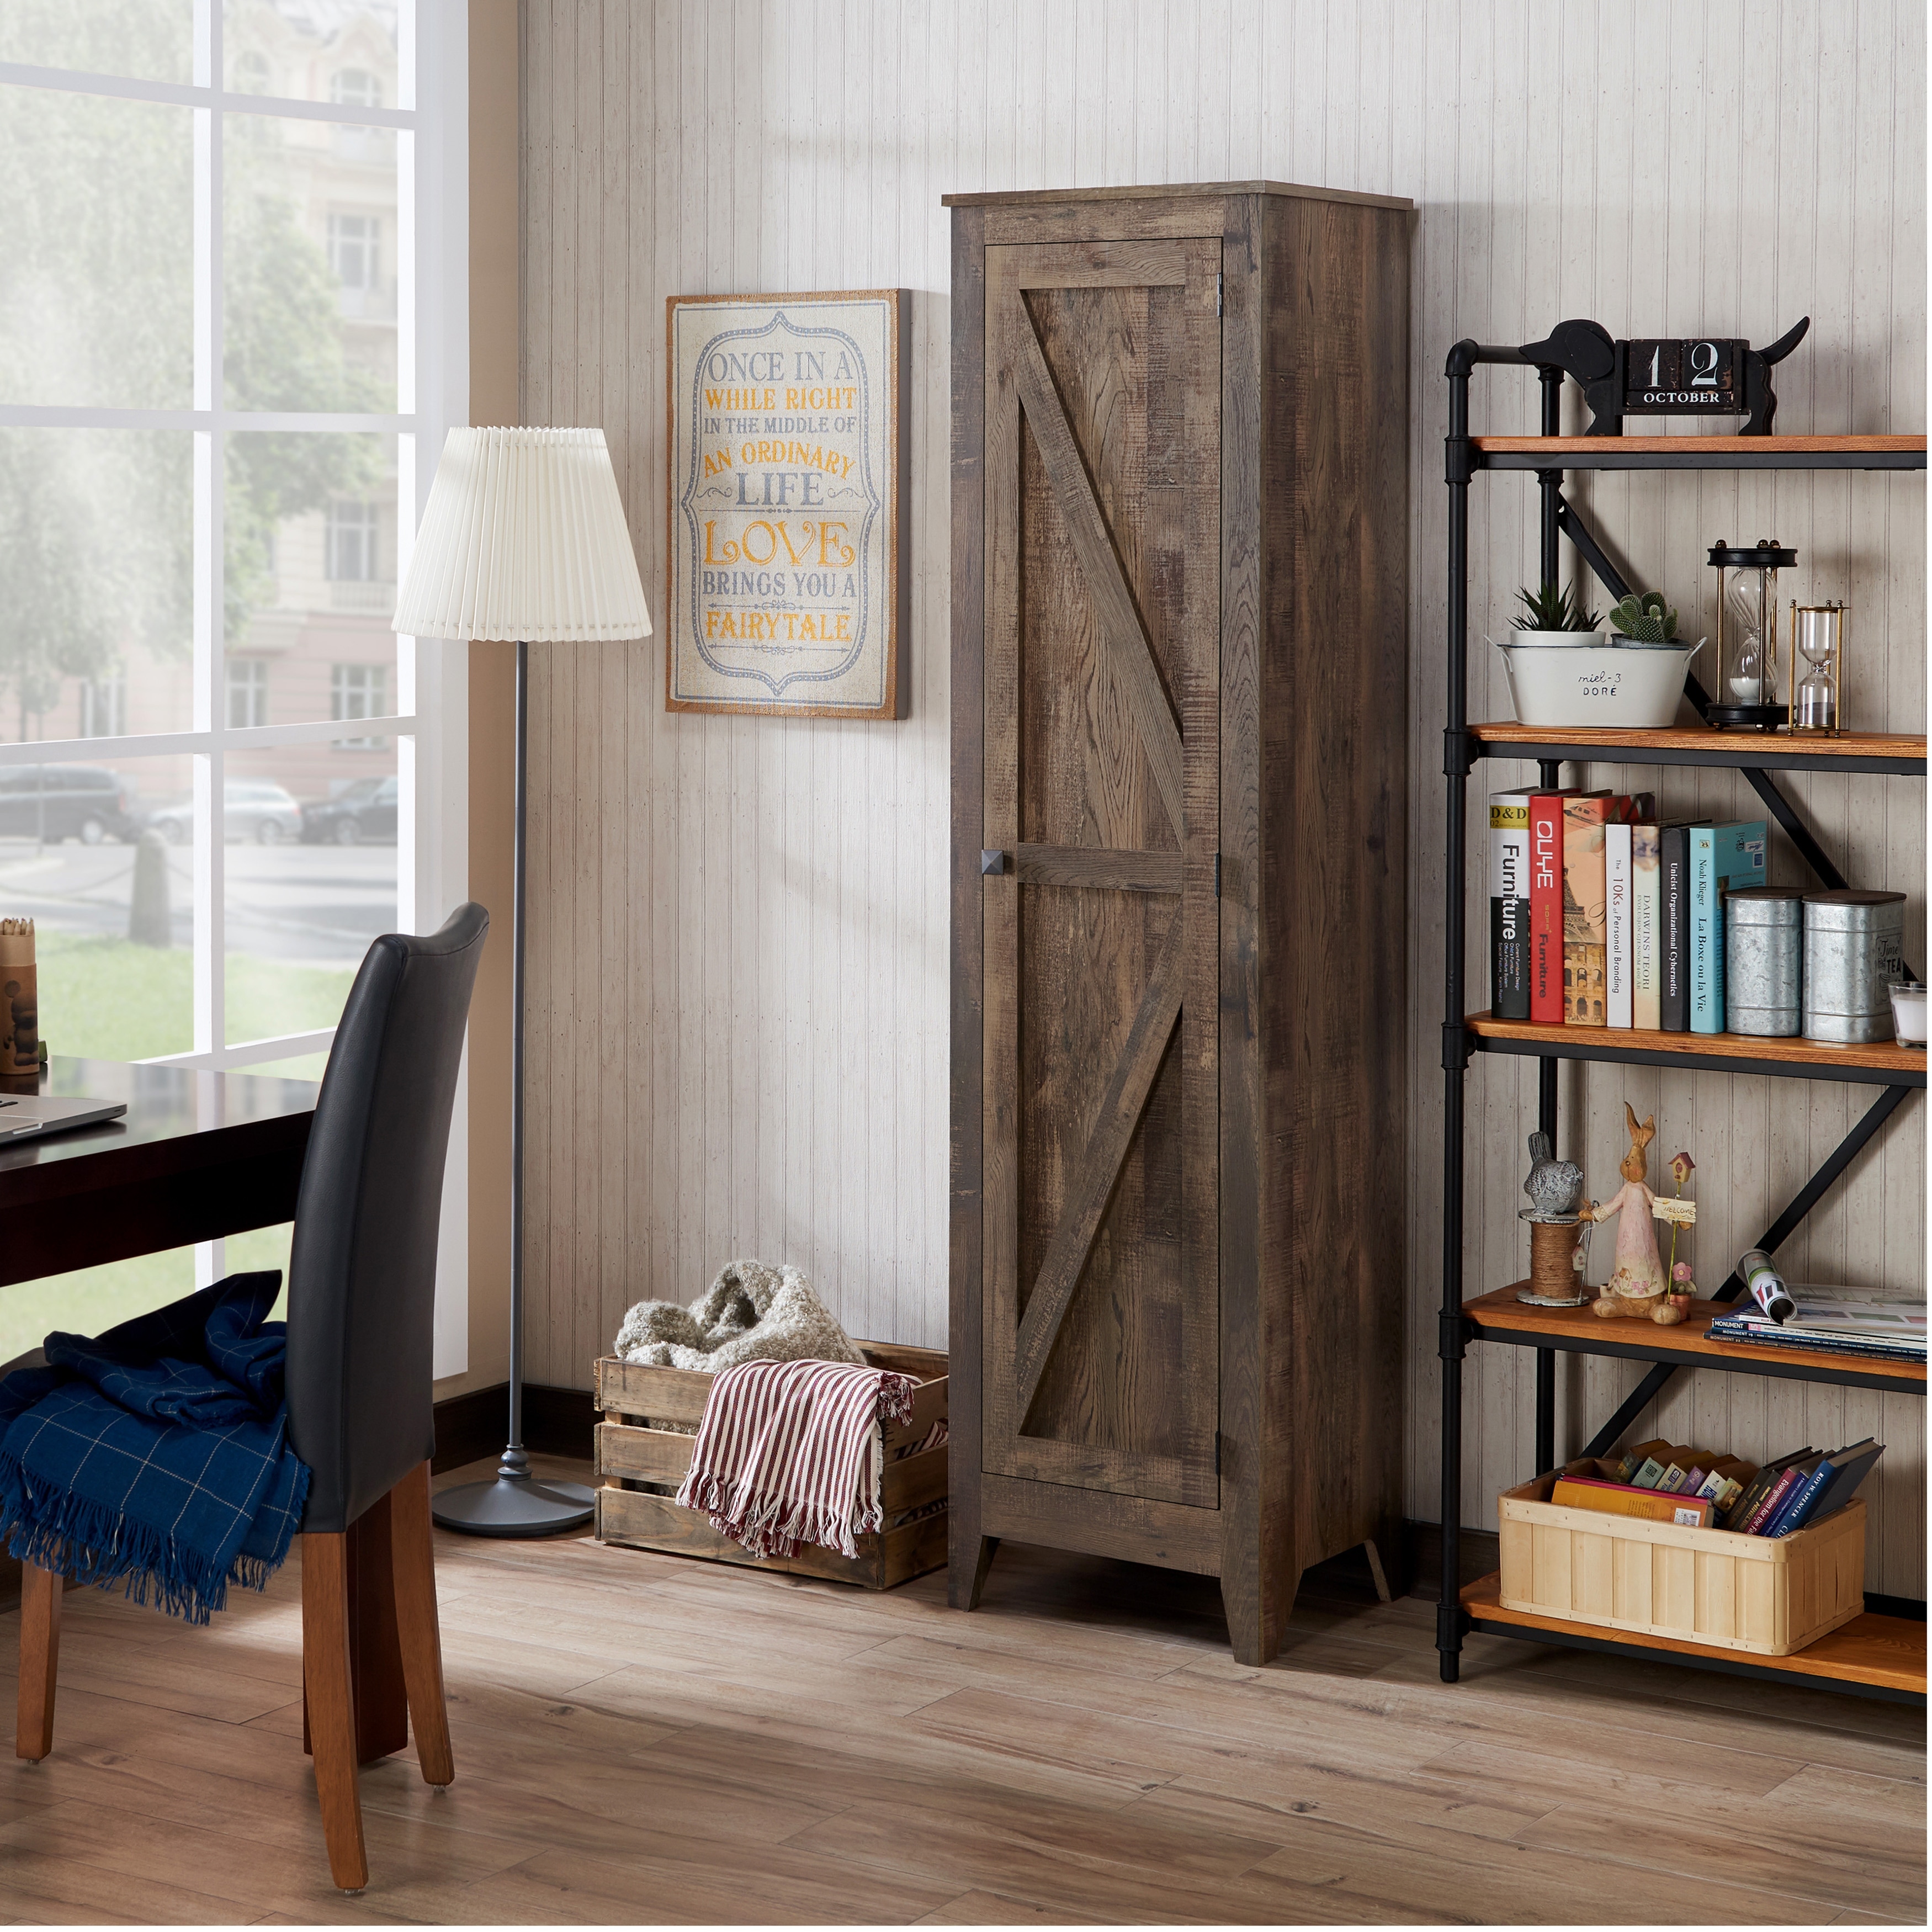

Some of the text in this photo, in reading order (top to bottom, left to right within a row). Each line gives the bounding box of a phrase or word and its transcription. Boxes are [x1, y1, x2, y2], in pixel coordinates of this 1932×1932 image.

[708, 351, 853, 383] ONCE IN A
[1648, 343, 1718, 386] 1 2
[704, 388, 857, 411] WHILE RIGHT
[1644, 392, 1719, 403] OCTOBER
[704, 417, 857, 434] IN THE MIDDLE OF
[703, 440, 856, 480] AN ORDINARY
[735, 473, 824, 506] LIFE
[704, 520, 856, 568] LOVE
[703, 571, 857, 598] BRINGS YOU A
[705, 612, 852, 641] FAIRYTALE
[1583, 685, 1617, 696] DORÉ
[1503, 845, 1519, 940] Furniture
[1613, 878, 1623, 905] 10Ks
[1696, 859, 1707, 905] Noah Klieger
[1613, 916, 1622, 953] Personal
[1669, 892, 1678, 949] Organizational
[1880, 938, 1898, 957] Time
[1539, 934, 1548, 998] Furniture
[1612, 957, 1621, 993] Branding
[1697, 917, 1707, 1012] La Boxe ou la Vie
[1887, 957, 1901, 973] TEA
[1663, 1207, 1694, 1215] WELCOME
[1715, 1320, 1744, 1329] MONUMENT
[1813, 1472, 1824, 1485] ROY
[1766, 1479, 1789, 1509] Evangelism
[1791, 1492, 1811, 1518] SPENCER
[1754, 1517, 1763, 1527] the
[1761, 1508, 1769, 1517] for
